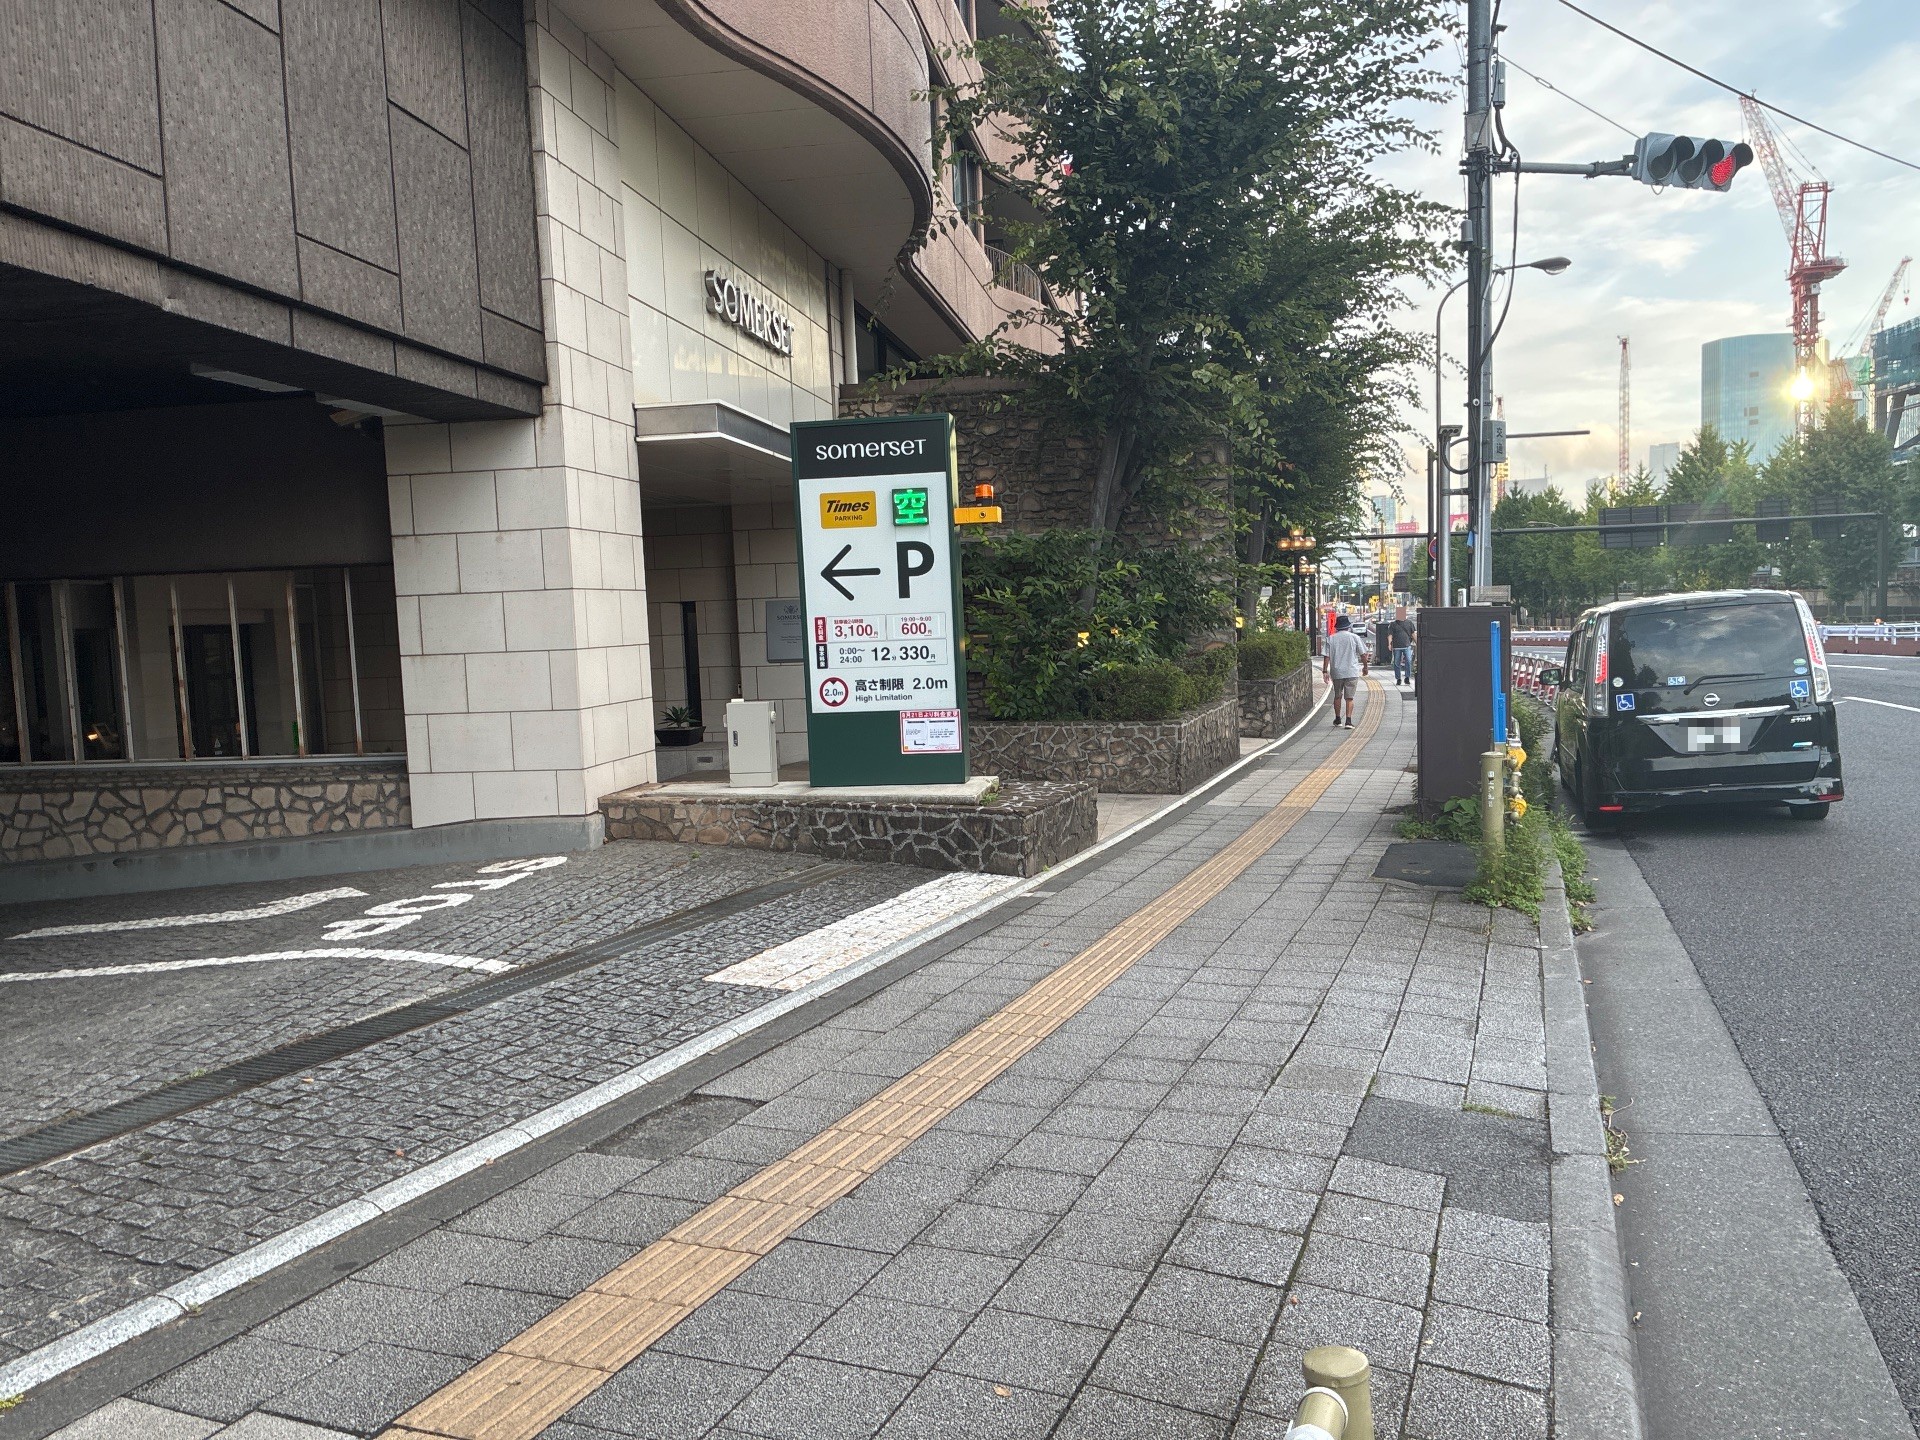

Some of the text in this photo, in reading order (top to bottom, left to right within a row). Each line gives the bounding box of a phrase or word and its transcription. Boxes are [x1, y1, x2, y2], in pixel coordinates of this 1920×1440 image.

[705, 270, 794, 357] SOMERSET
[826, 500, 870, 513] Times
[893, 489, 928, 524] 空
[896, 541, 935, 598] P
[824, 688, 844, 696] 2.0m
[855, 677, 948, 692] 高さ制限 2.0m
[855, 695, 873, 703] High
